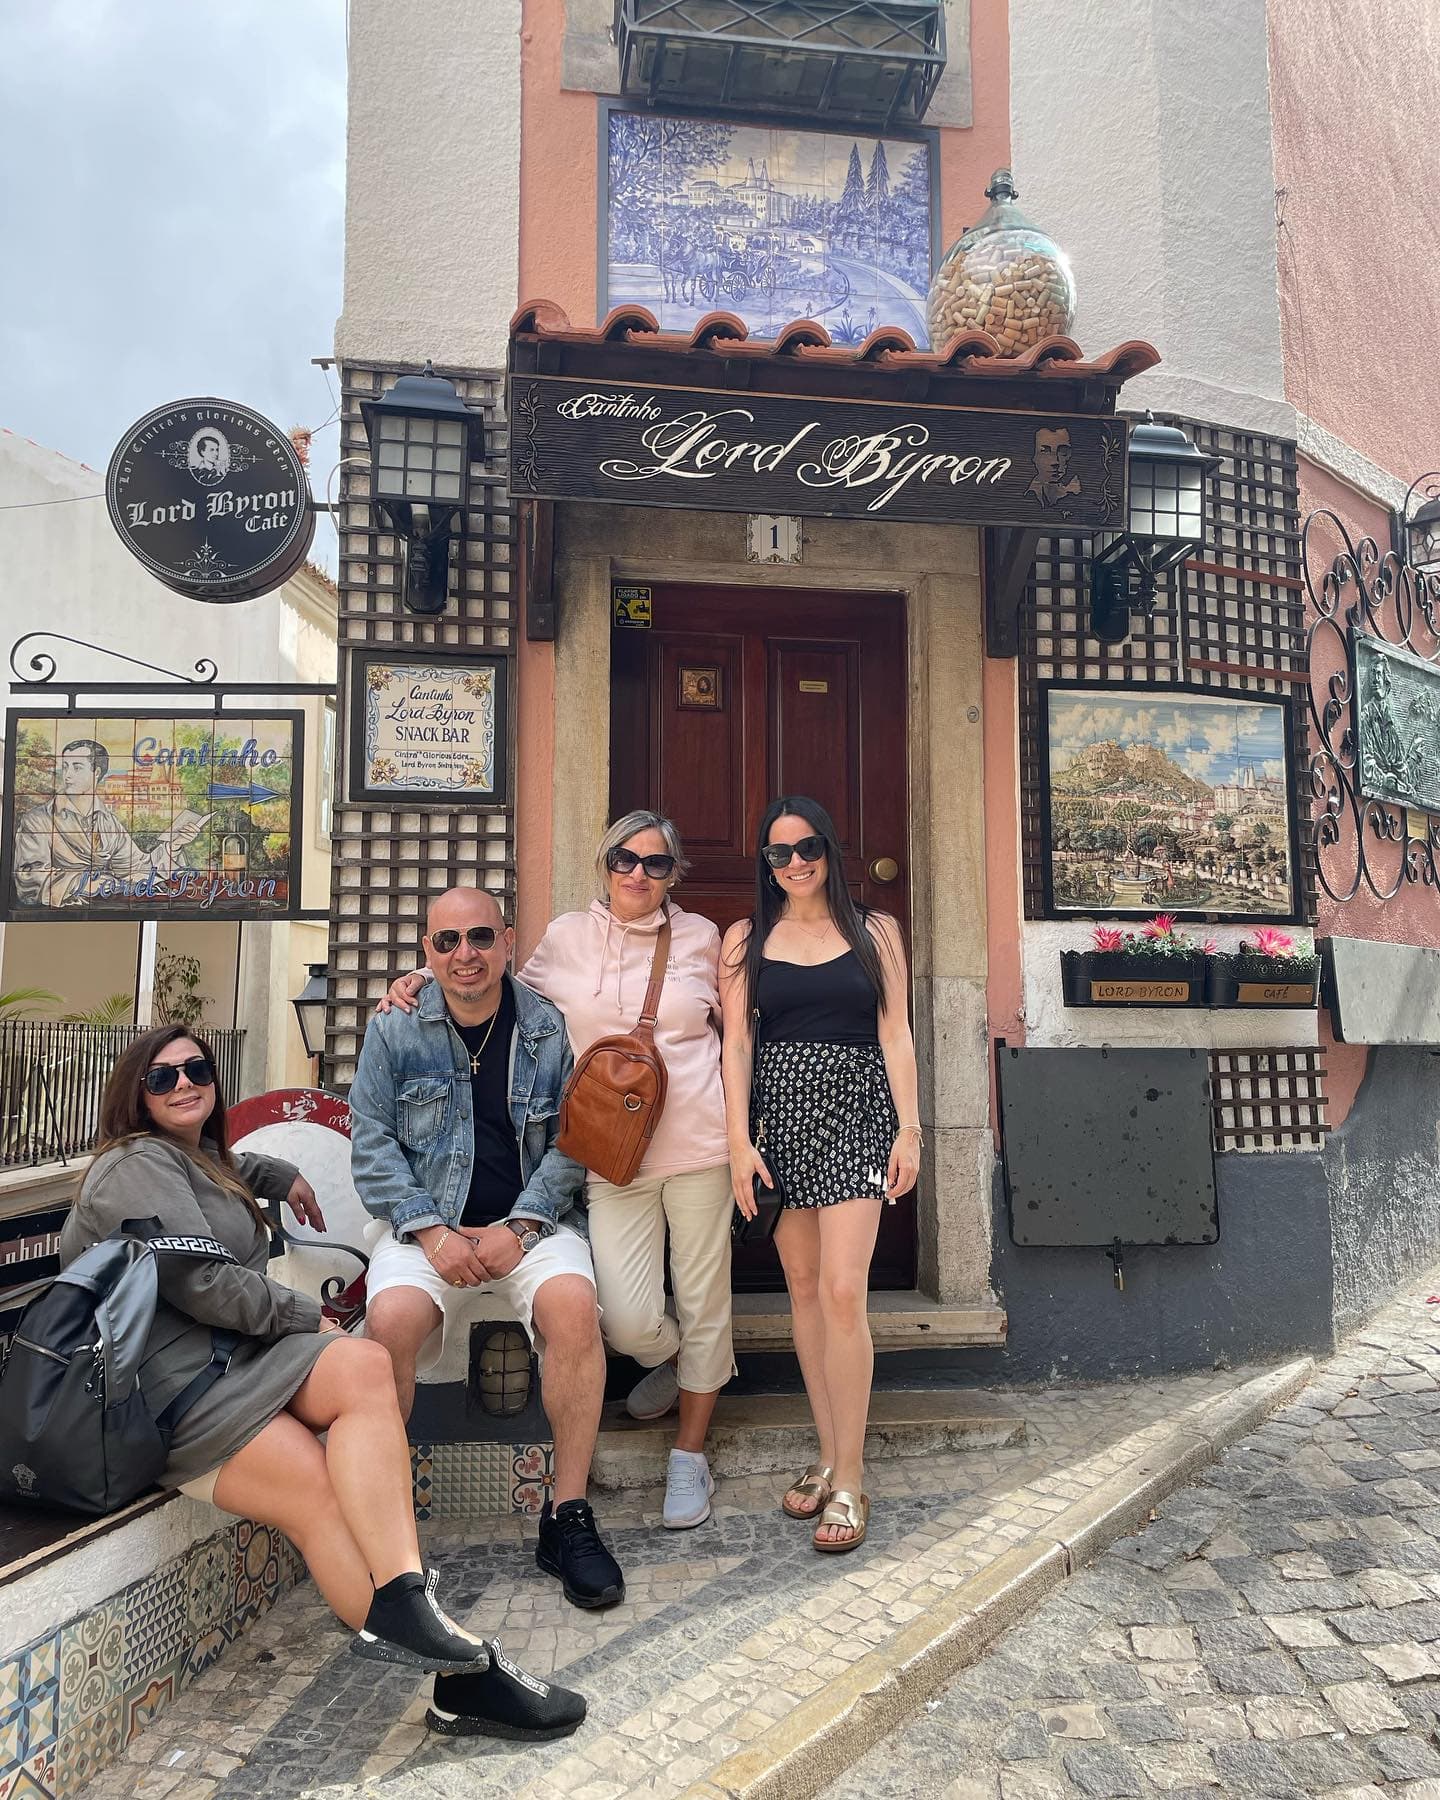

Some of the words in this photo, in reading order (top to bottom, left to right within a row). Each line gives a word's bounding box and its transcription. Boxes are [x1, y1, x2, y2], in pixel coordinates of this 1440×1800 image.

[557, 393, 662, 421] Cantinho
[132, 413, 187, 453] Cintra's
[196, 409, 263, 437] glorious
[600, 409, 821, 480] Lord
[796, 423, 1013, 511] Byron
[126, 499, 196, 529] Lord
[206, 489, 296, 522] Byron
[770, 524, 779, 549] 1
[409, 684, 453, 701] Cantinho
[385, 697, 426, 722] Lord
[425, 703, 476, 726] Byron
[395, 726, 439, 742] SNACK
[442, 727, 470, 743] BAR
[133, 736, 281, 768] Cantinho
[72, 866, 158, 899] Lord
[165, 867, 277, 909] Byron
[1098, 985, 1134, 998] LORD
[1139, 986, 1184, 998] BYRON
[1263, 986, 1289, 999] CAFÉ
[521, 1675, 546, 1692] KORS
